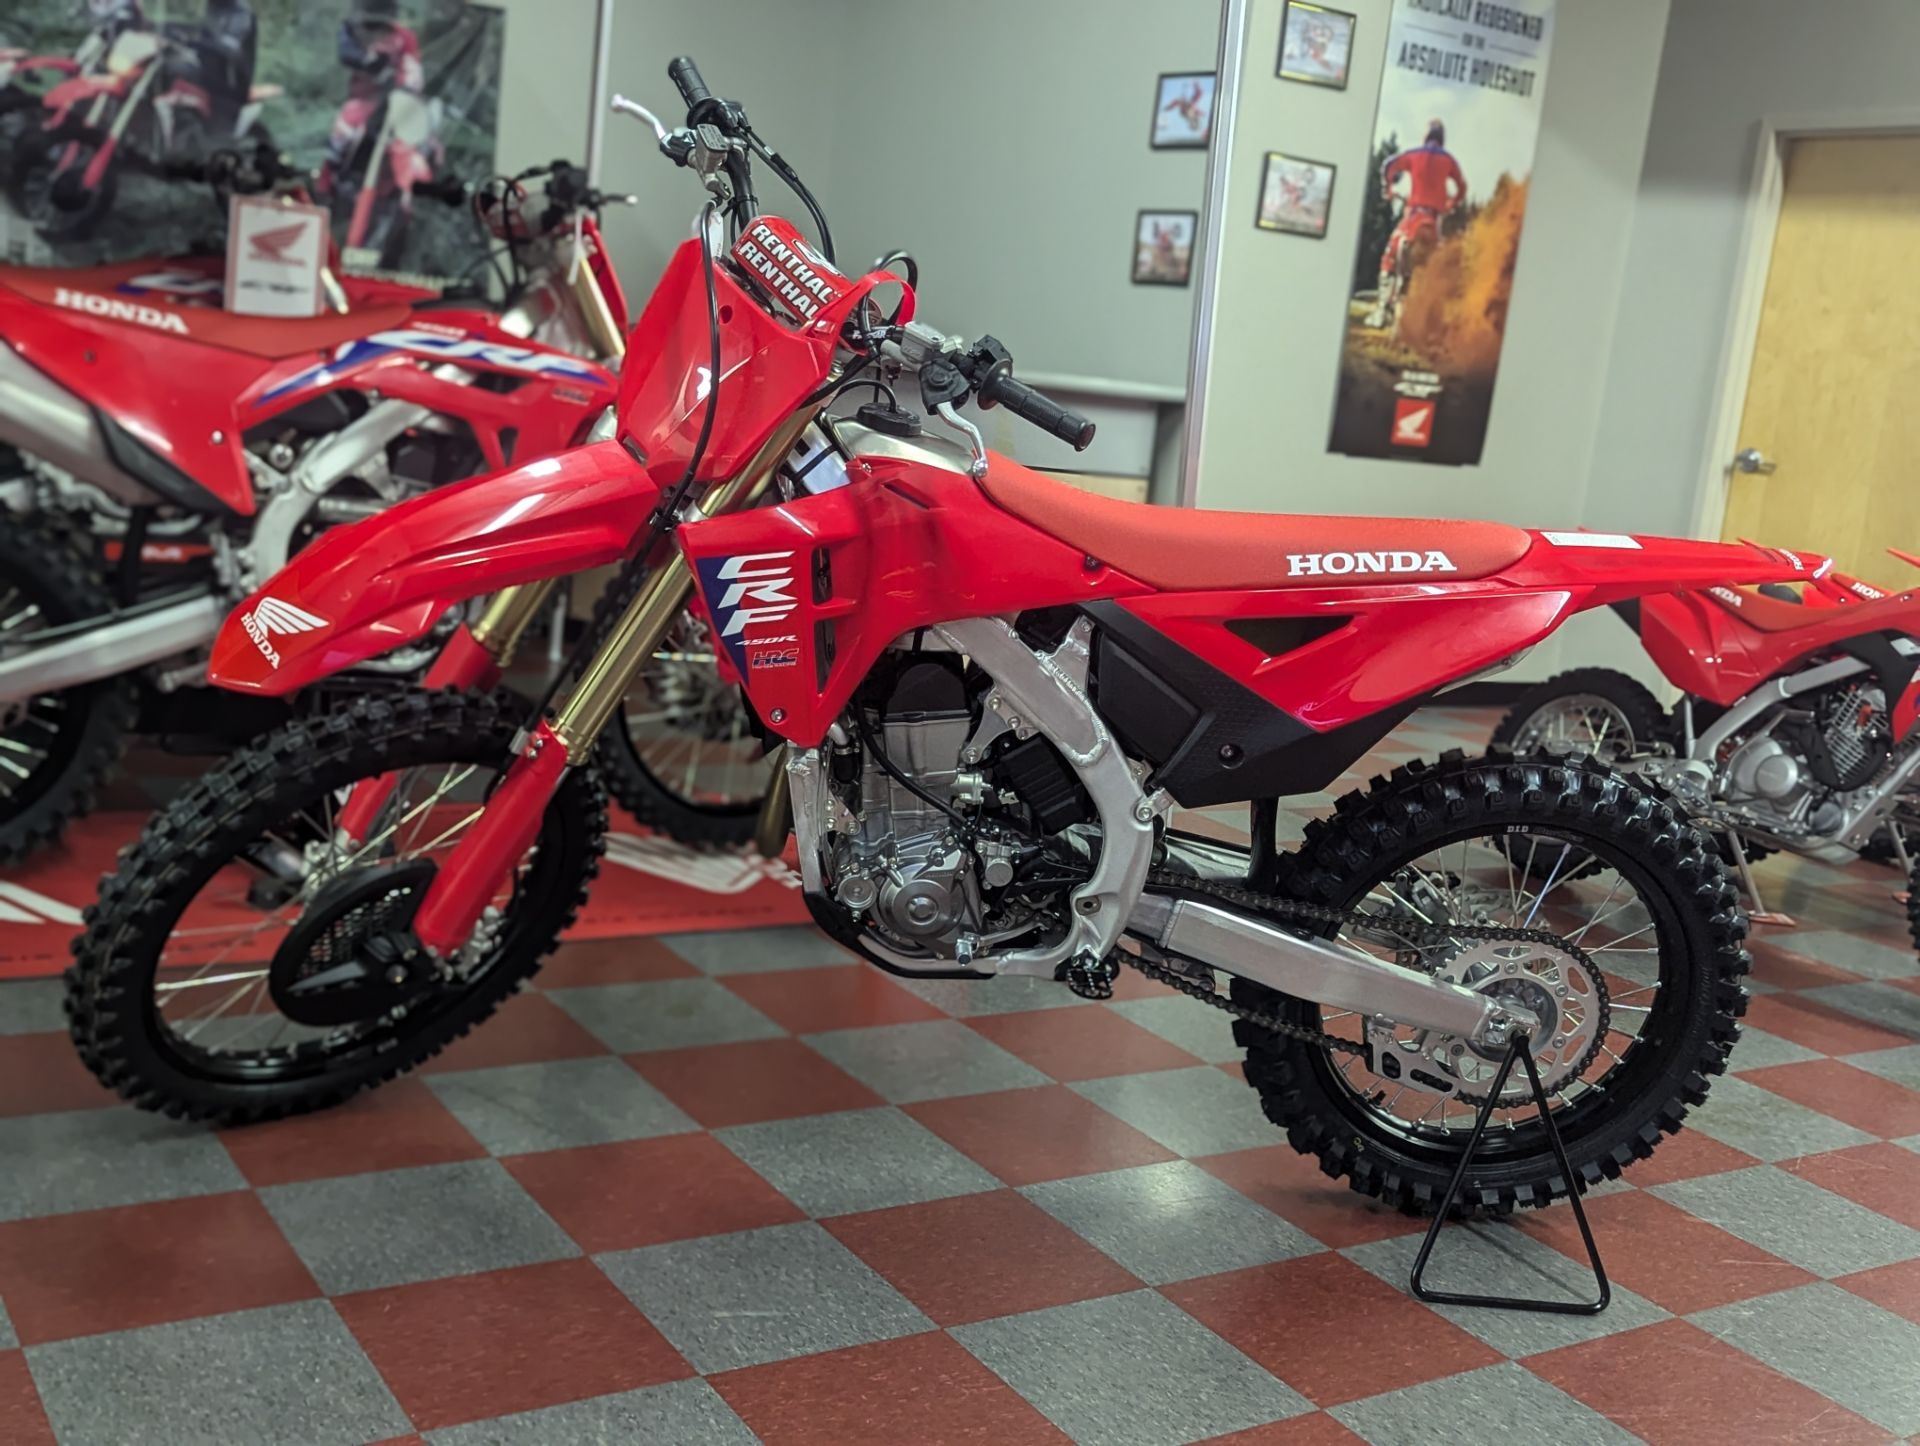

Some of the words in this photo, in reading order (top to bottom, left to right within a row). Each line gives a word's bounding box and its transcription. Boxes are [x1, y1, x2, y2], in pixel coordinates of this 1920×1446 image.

[1474, 1, 1543, 41] REDESIGNED
[1397, 41, 1469, 83] ABSOLUTE
[1469, 57, 1537, 98] HOLESHOT
[740, 241, 819, 319] RENTHAL
[751, 224, 833, 304] RENTHAL
[54, 288, 190, 334] HONDA
[1286, 551, 1458, 576] HONDA
[717, 551, 799, 637] CRF
[1710, 586, 1743, 608] NDA
[1851, 582, 1884, 600] HON
[240, 612, 281, 670] HONDA
[735, 634, 799, 646] 450R
